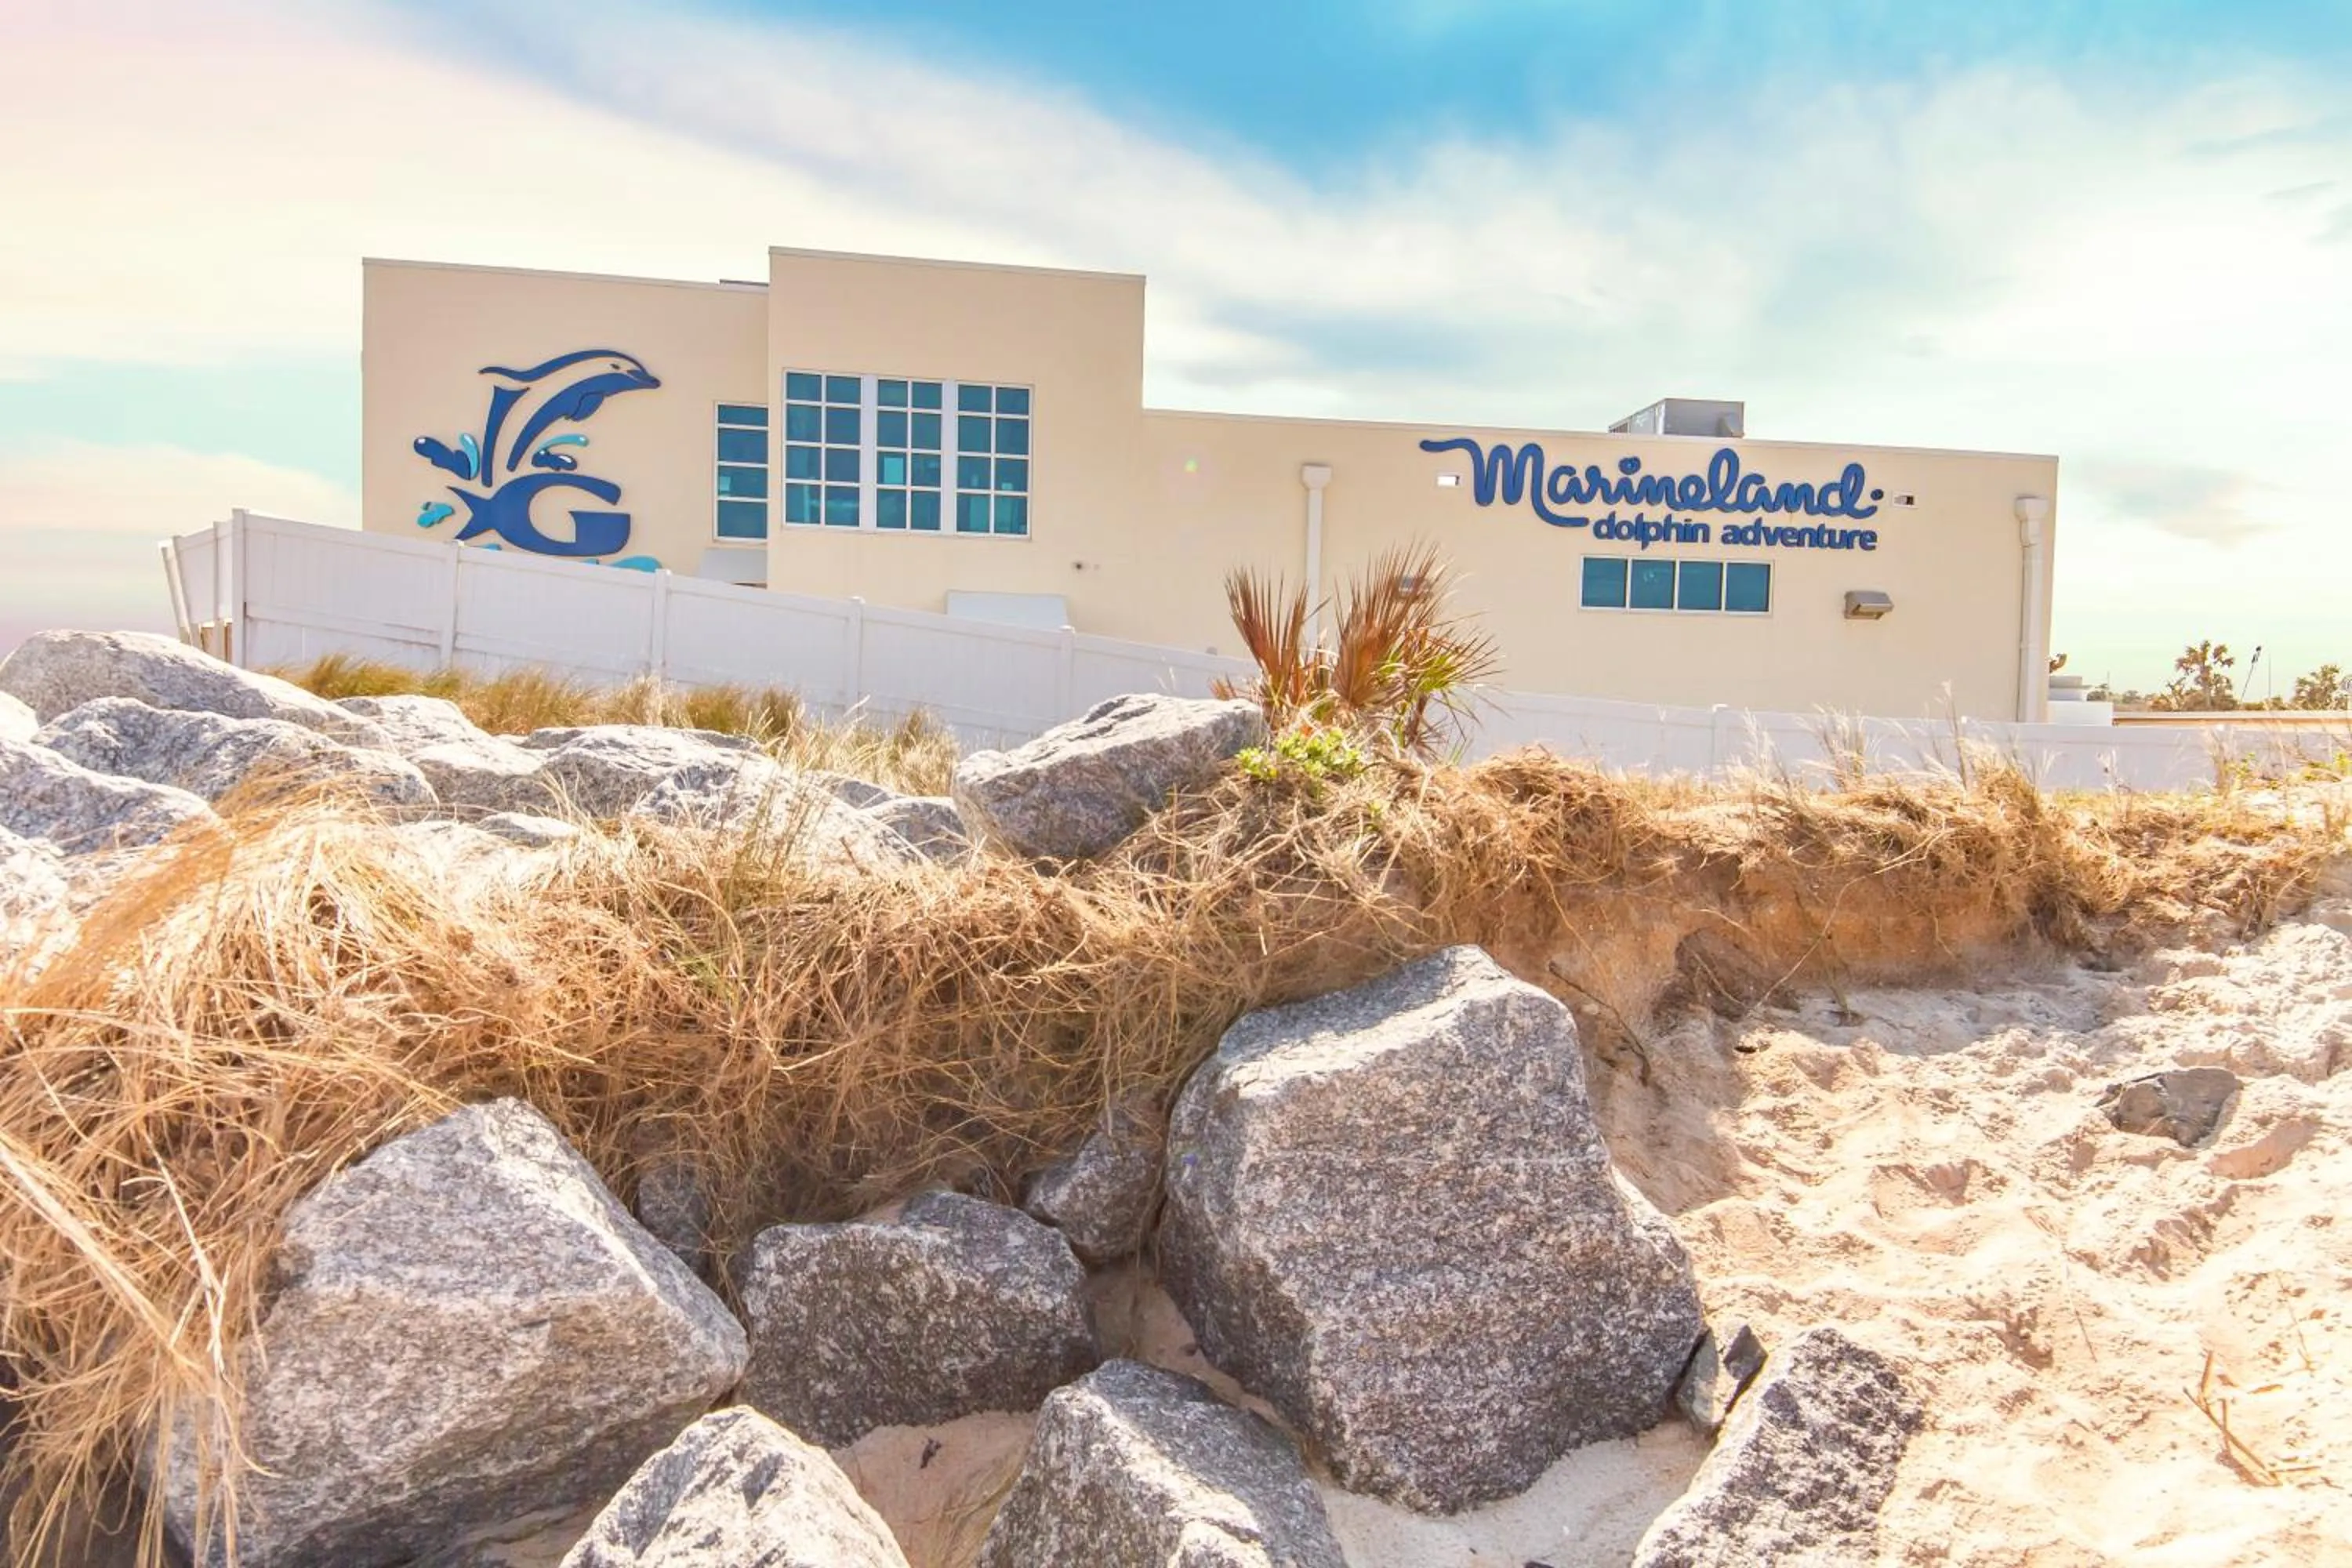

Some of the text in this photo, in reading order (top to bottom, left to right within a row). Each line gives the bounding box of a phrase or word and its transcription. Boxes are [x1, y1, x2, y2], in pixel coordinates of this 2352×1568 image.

[1420, 437, 1879, 528] Marineland
[1592, 511, 1878, 550] dolphin adventure
